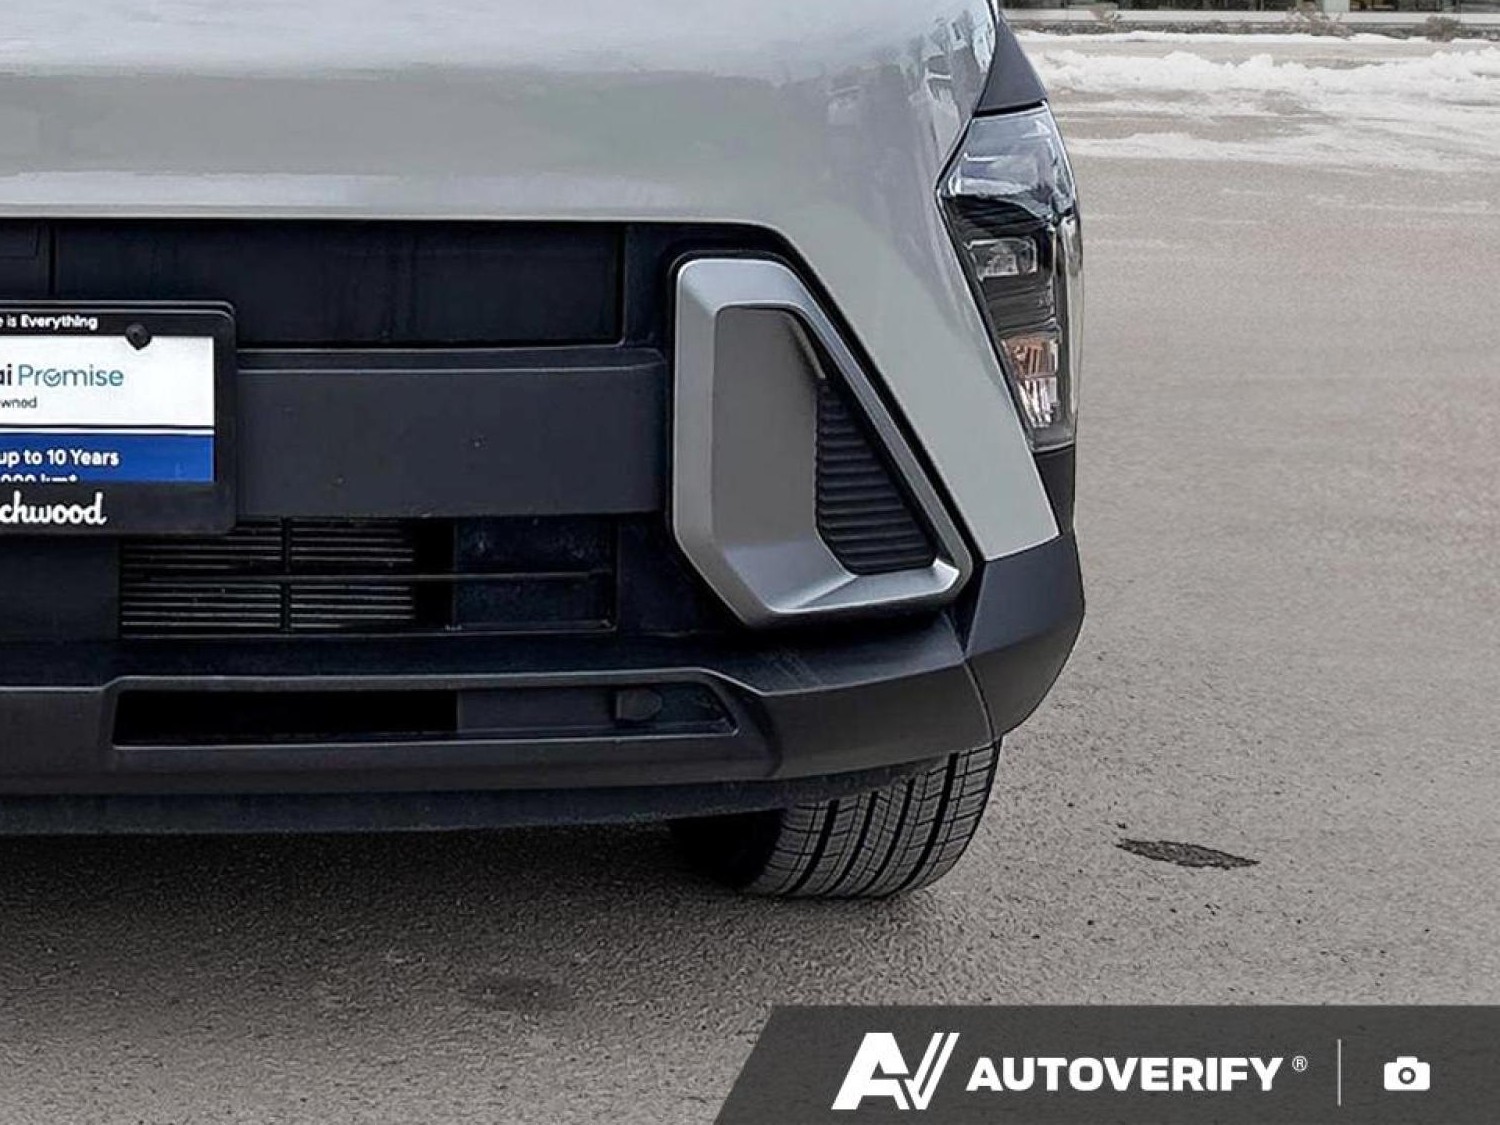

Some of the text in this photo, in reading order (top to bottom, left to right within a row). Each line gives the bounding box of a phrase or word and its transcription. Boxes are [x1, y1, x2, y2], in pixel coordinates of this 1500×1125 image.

[6, 314, 17, 327] is
[21, 314, 98, 331] Everything
[17, 363, 125, 387] Promise
[24, 449, 43, 465] to
[47, 449, 66, 465] 10
[69, 449, 120, 466] Years
